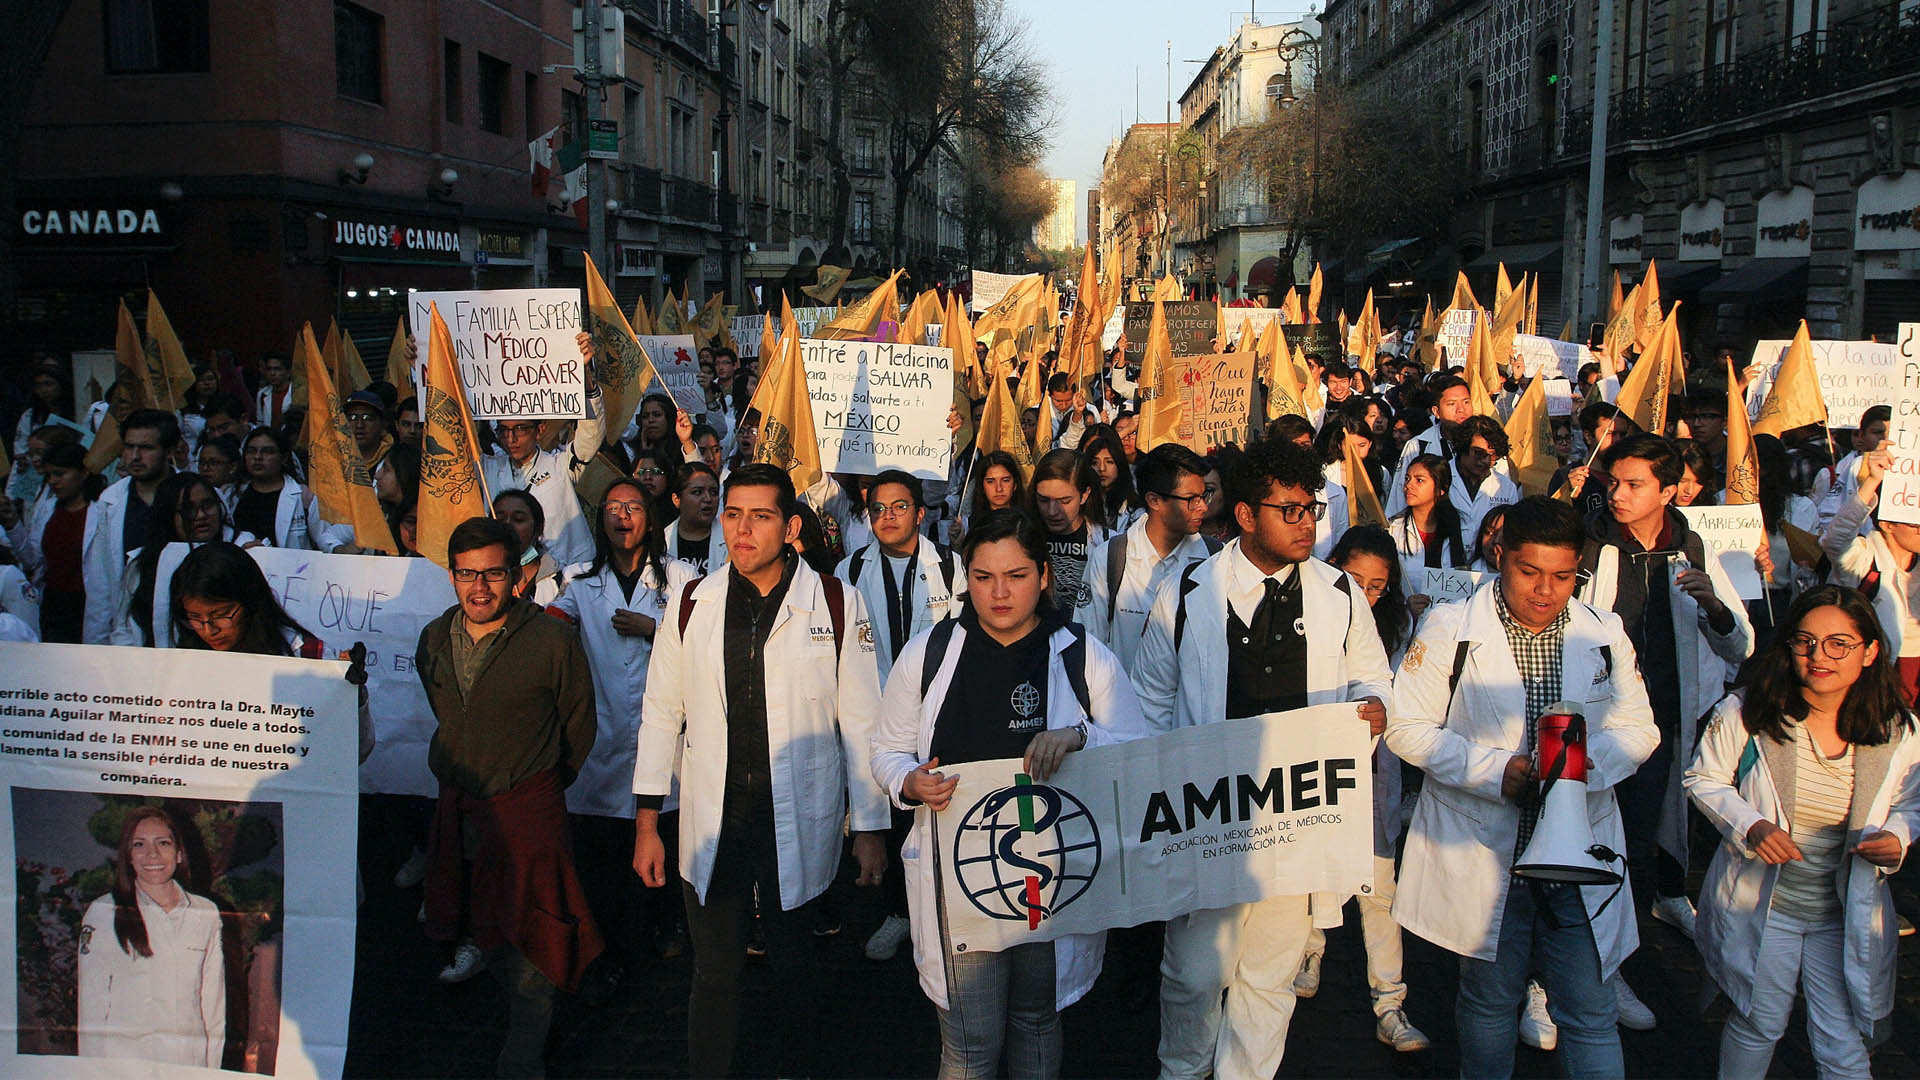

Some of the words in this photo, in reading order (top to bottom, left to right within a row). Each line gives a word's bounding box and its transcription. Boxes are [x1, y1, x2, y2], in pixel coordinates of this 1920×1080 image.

[23, 210, 160, 234] CANADA
[335, 220, 388, 247] JUGOS
[406, 228, 460, 252] CANADA
[416, 301, 431, 331] M
[455, 301, 520, 332] FAMILIA
[528, 299, 581, 330] ESPERA
[1130, 304, 1200, 318] ESTAMOS
[1167, 320, 1216, 329] ROTEGER
[484, 332, 547, 360] MÉDICO
[857, 350, 867, 365] a
[875, 345, 949, 370] Medicina
[1841, 344, 1864, 366] la
[462, 363, 491, 388] UN
[501, 359, 581, 386] CADÁVER
[807, 371, 826, 381] ara
[832, 372, 863, 389] poder
[869, 369, 932, 389] SALVAR
[1820, 373, 1848, 389] era
[841, 392, 848, 412] y
[853, 390, 900, 406] salvarte
[904, 399, 912, 407] a
[1209, 381, 1244, 402] haya
[1823, 393, 1887, 408] studiante
[1209, 399, 1245, 415] batas
[824, 408, 900, 432] MÉXICO
[817, 436, 830, 449] or
[834, 434, 860, 462] qué
[865, 441, 892, 456] nos
[897, 438, 951, 468] matas?
[1890, 457, 1920, 475] ca
[1892, 482, 1920, 508] de
[319, 580, 388, 633] QUE
[54, 692, 88, 702] acto
[93, 694, 163, 707] cometido
[169, 698, 216, 710] contra
[221, 700, 233, 712] la
[238, 701, 266, 714] Dra.
[271, 704, 315, 719] Mayté
[50, 708, 104, 722] Aguilar
[109, 711, 175, 725] Martínez
[179, 716, 205, 727] nos
[210, 717, 248, 730] duele
[252, 722, 260, 731] a
[265, 722, 311, 734] todos.
[1008, 718, 1043, 729] AMMEF
[3, 728, 85, 742] comunidad
[89, 732, 107, 743] de
[112, 733, 125, 744] la
[131, 734, 176, 747] ENMH
[181, 739, 198, 748] se
[203, 740, 229, 750] une
[233, 742, 249, 752] en
[254, 743, 296, 754] duelo
[300, 746, 309, 757] y
[0, 743, 59, 757] lamenta
[64, 747, 77, 758] la
[82, 750, 144, 763] sensible
[149, 753, 205, 766] pérdida
[210, 757, 227, 768] de
[232, 759, 289, 771] nuestra
[100, 771, 187, 787] compañera.
[1139, 759, 1356, 842] AMMEF
[1161, 834, 1218, 857] ASOCIACIÓN
[1223, 824, 1273, 841] MEXICANA
[1278, 820, 1291, 831] DE
[1296, 814, 1342, 828] MÉDICOS
[1203, 849, 1217, 859] EN
[1220, 837, 1276, 855] FORMACIÓN
[1279, 833, 1297, 843] A.C.
